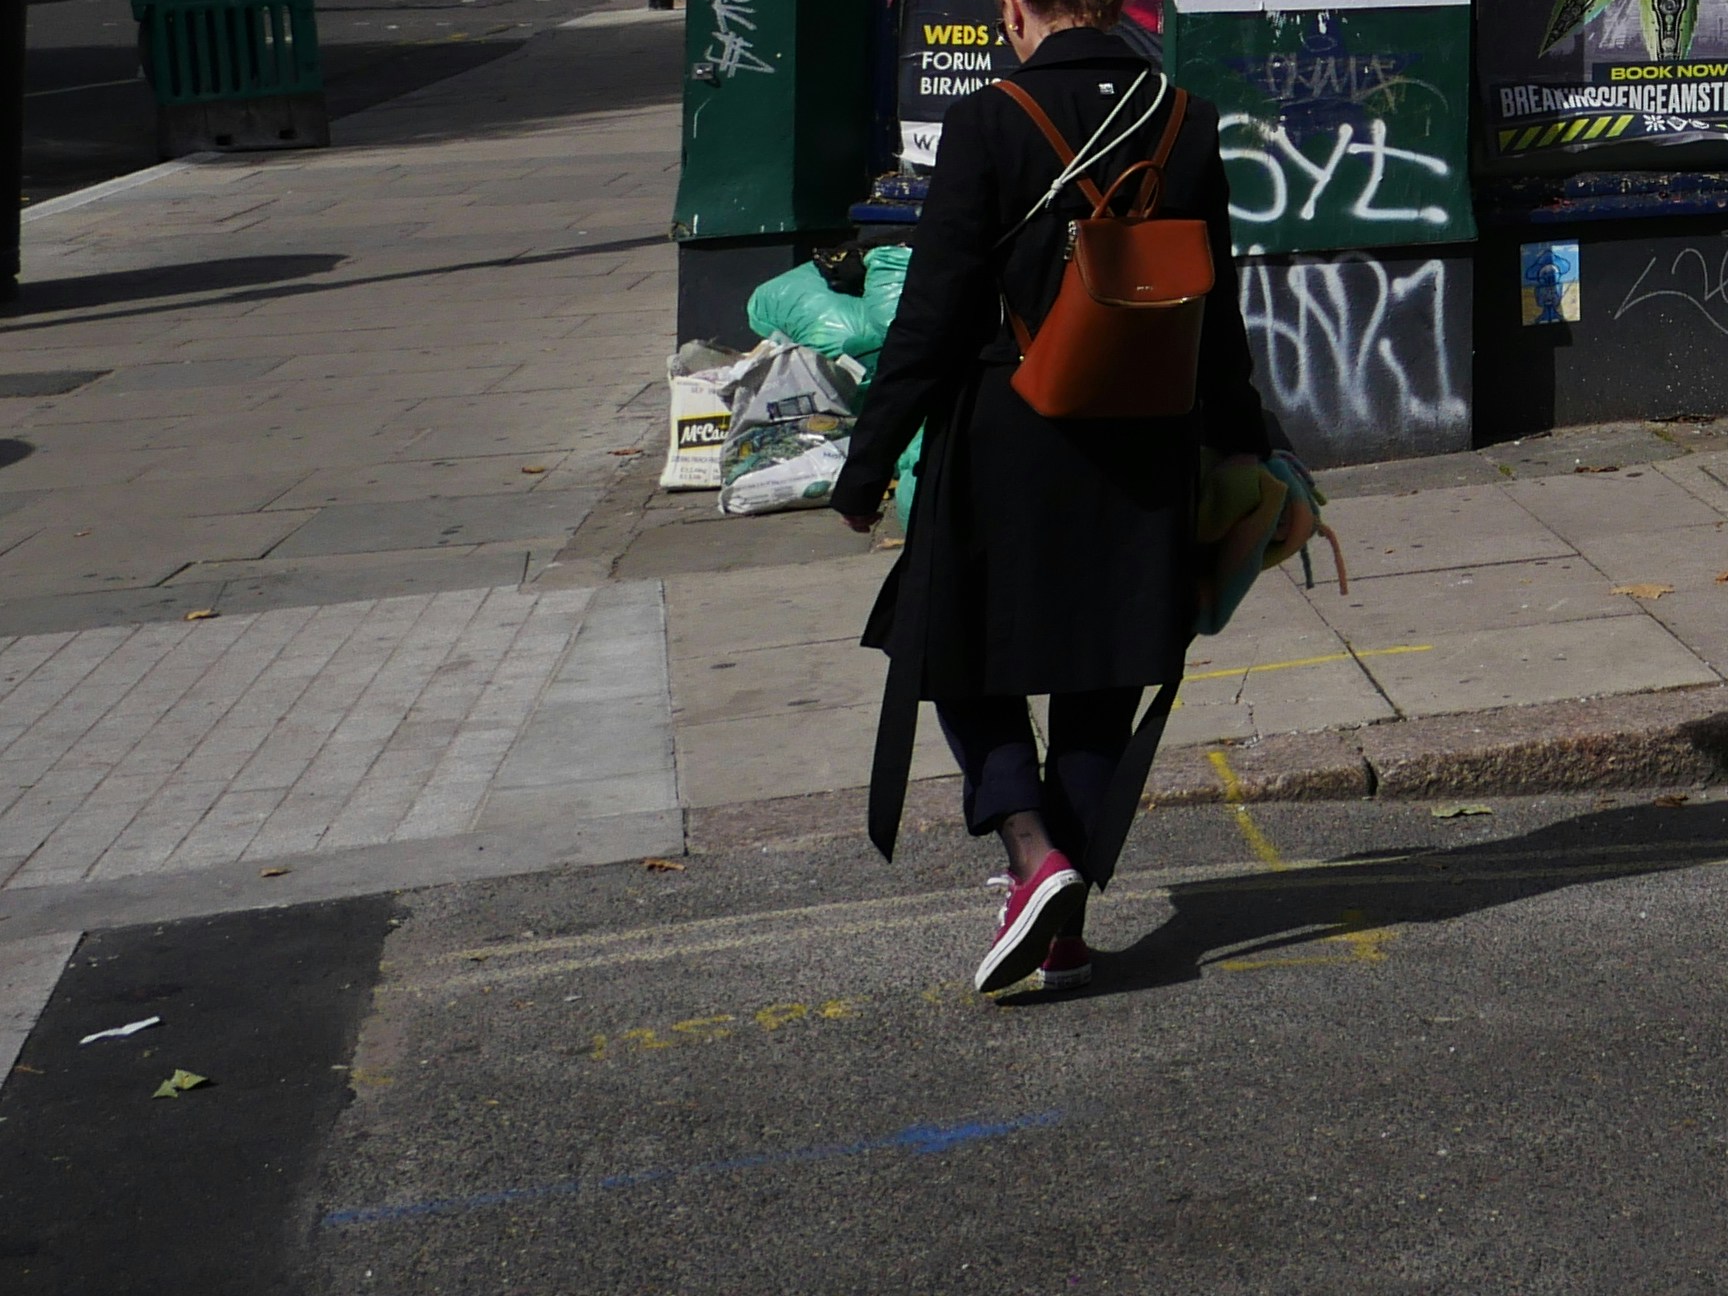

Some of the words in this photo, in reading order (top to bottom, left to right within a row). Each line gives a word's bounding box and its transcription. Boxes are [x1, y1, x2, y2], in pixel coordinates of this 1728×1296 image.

[923, 24, 989, 46] WEDS
[921, 51, 992, 71] FORUM
[1611, 66, 1673, 80] BOOK
[1677, 64, 1728, 78] NOW
